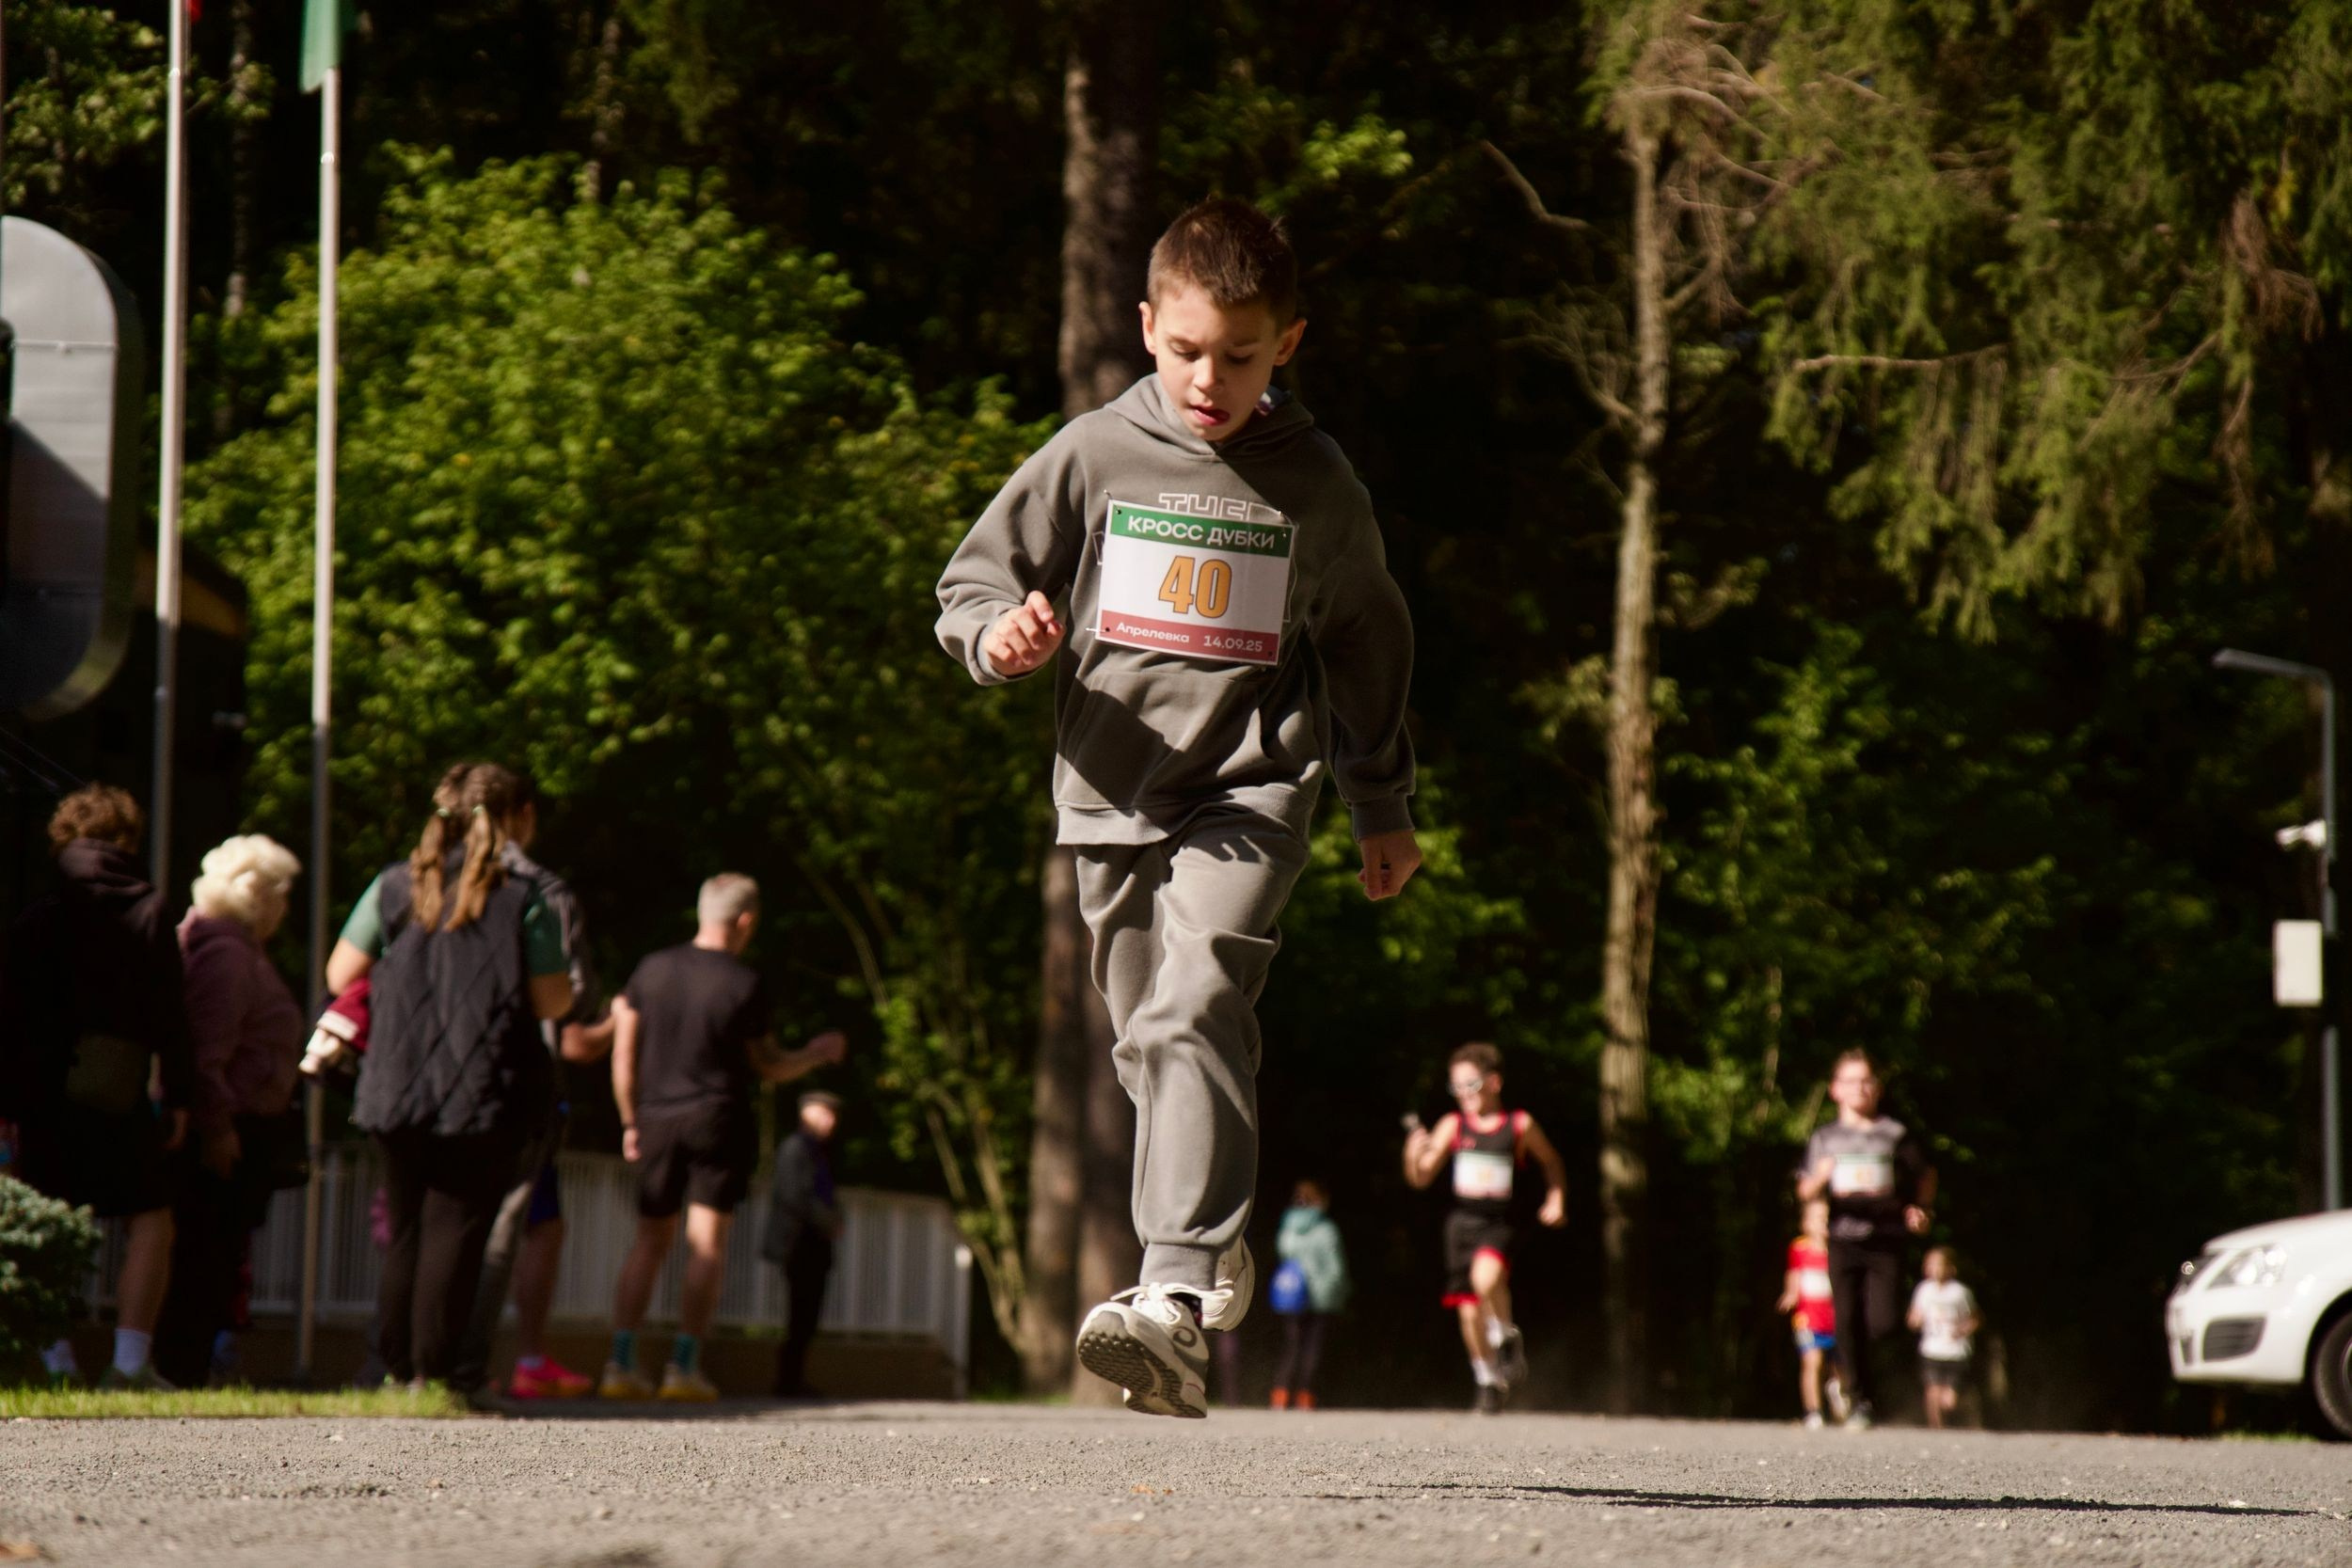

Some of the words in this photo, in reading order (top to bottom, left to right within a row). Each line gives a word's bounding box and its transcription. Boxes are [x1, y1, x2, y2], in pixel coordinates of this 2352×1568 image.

[1127, 515, 1204, 541] КРОСС
[1206, 529, 1275, 549] ДУБКИ
[1158, 555, 1232, 619] 40
[1116, 622, 1190, 643] Апрелевка
[1203, 635, 1263, 653] 14.09.25
